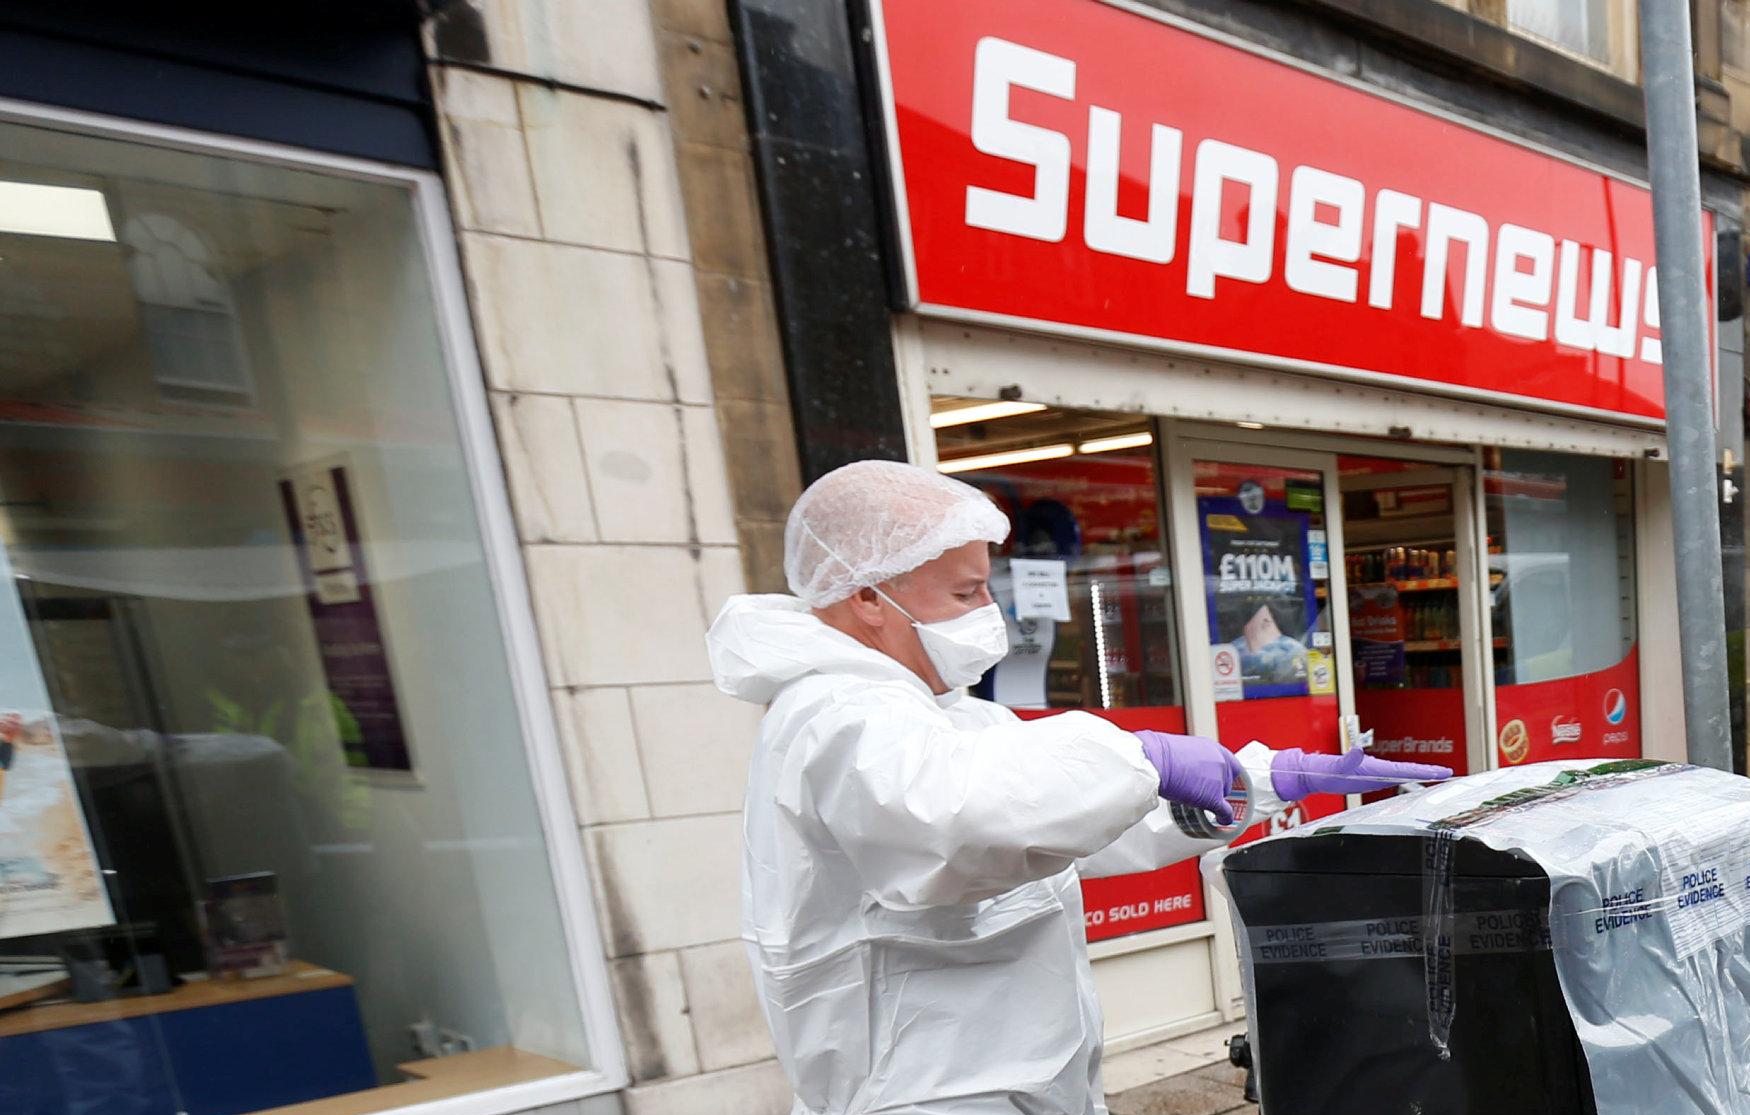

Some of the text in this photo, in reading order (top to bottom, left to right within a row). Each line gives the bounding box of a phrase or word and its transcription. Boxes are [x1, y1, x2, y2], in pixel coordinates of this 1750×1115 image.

[1219, 554, 1297, 581] £110M
[1371, 736, 1454, 754] uperBrands
[1682, 868, 1718, 890] POLICE
[1677, 883, 1725, 909] EVIDENCE
[1108, 902, 1150, 923] SOLD
[1153, 894, 1193, 914] HERE
[1266, 926, 1316, 943] POLICE
[1367, 920, 1418, 938] POLICE
[1260, 943, 1328, 960] EVIDENCE
